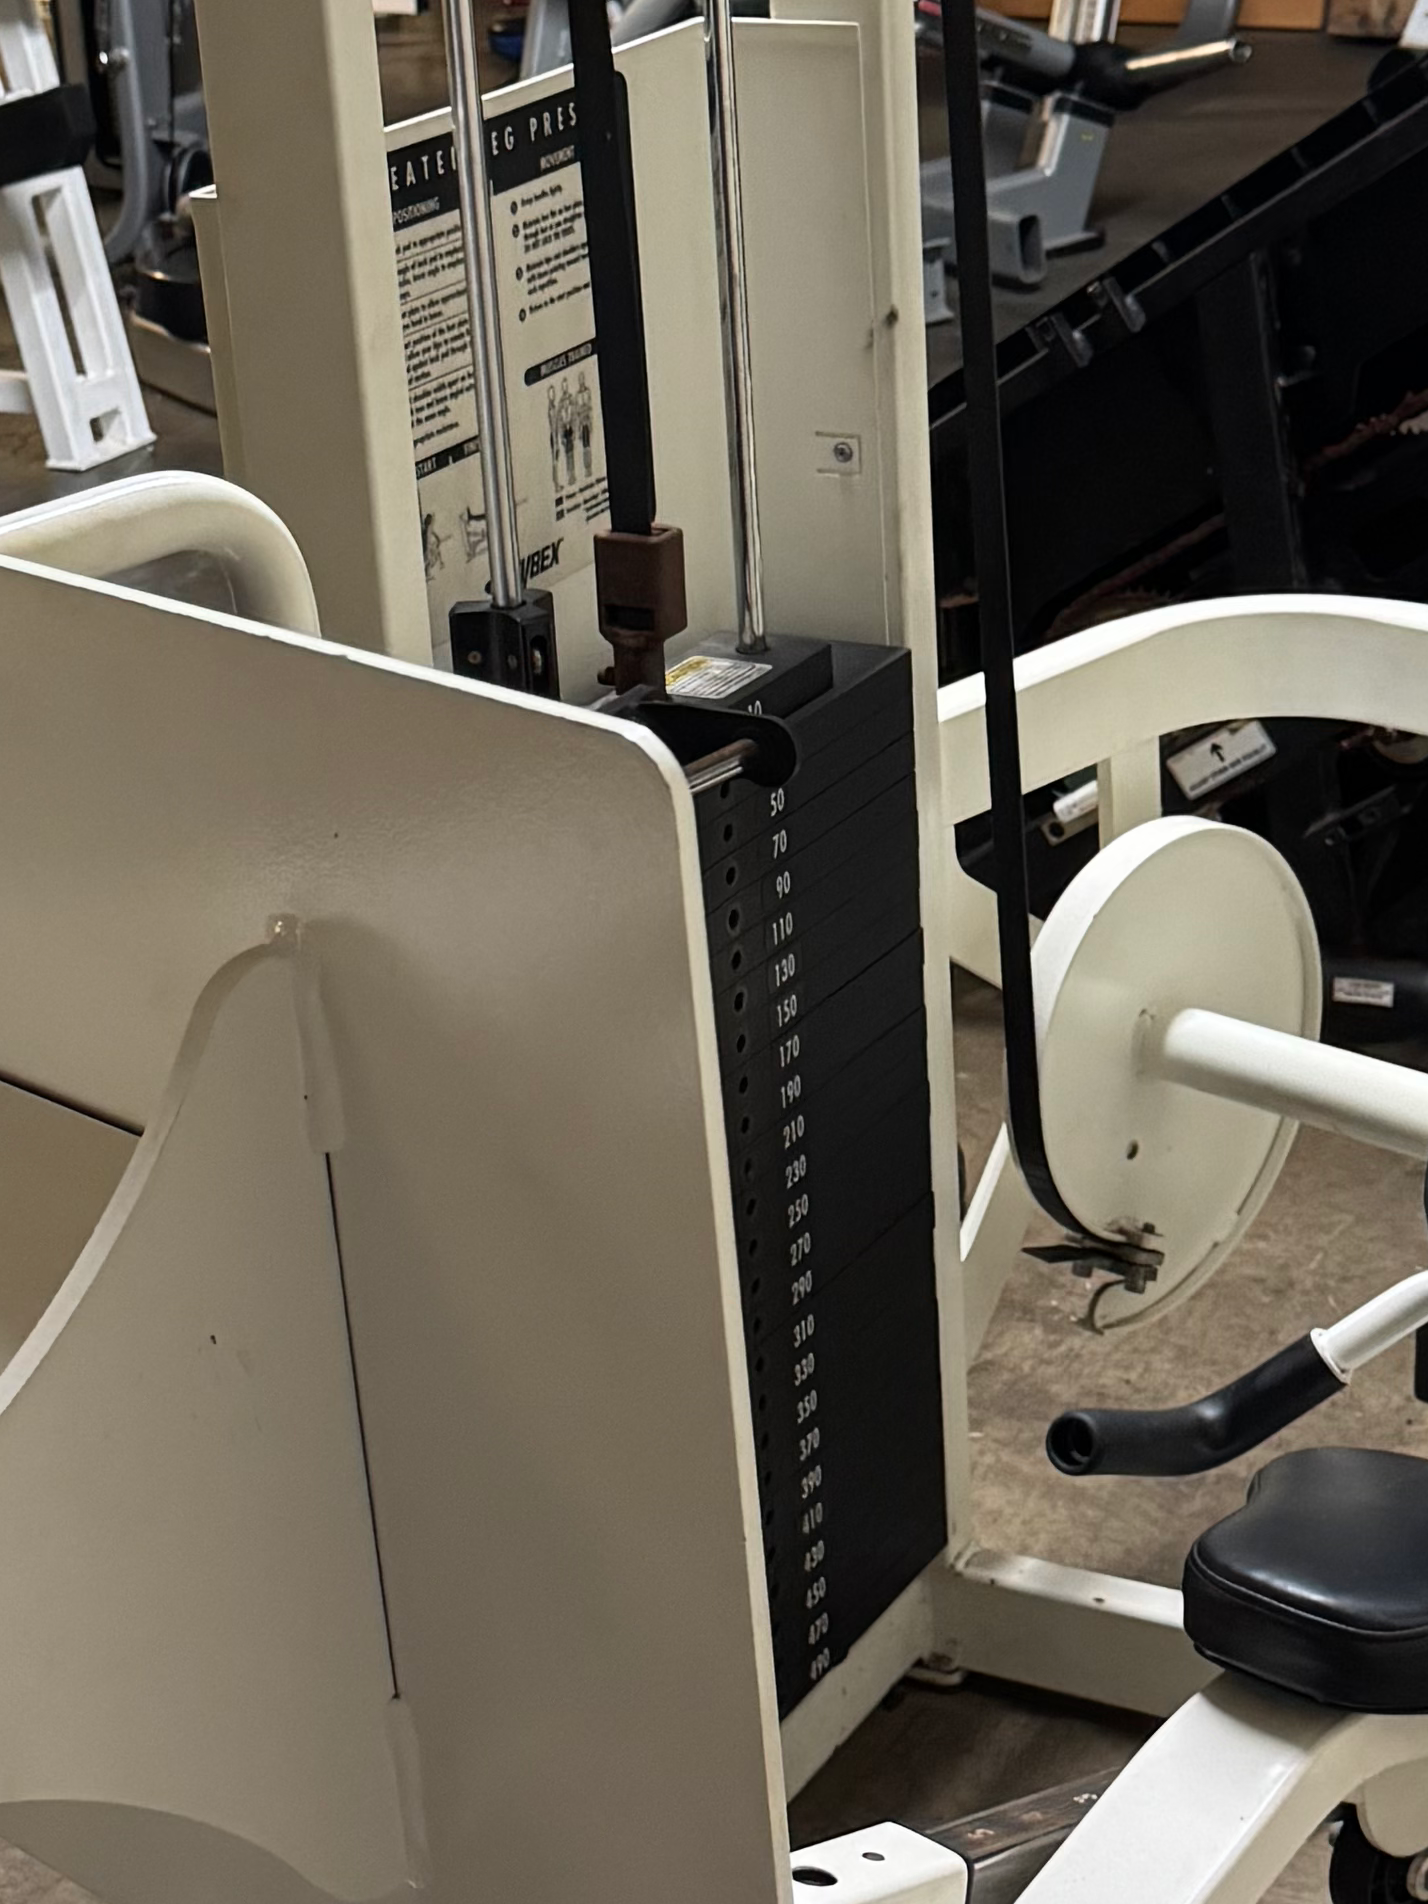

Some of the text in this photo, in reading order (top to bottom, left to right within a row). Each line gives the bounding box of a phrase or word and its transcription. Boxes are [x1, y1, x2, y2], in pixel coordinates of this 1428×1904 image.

[770, 788, 785, 817] 50
[772, 829, 787, 859] 70
[776, 871, 791, 899] 90
[772, 912, 793, 945] 110
[775, 953, 795, 987] 130
[777, 994, 797, 1027] 150
[779, 1034, 800, 1068] 170
[781, 1074, 801, 1109] 190
[783, 1114, 805, 1150] 210
[785, 1154, 806, 1189] 230
[788, 1193, 809, 1228] 250
[790, 1232, 811, 1267] 270
[791, 1270, 812, 1306] 290
[793, 1313, 814, 1348] 310
[794, 1352, 815, 1386] 330
[797, 1389, 818, 1424] 350
[799, 1427, 820, 1461] 370
[801, 1464, 822, 1499] 390
[802, 1502, 823, 1534] 410
[804, 1539, 825, 1572] 430
[806, 1576, 826, 1609] 450
